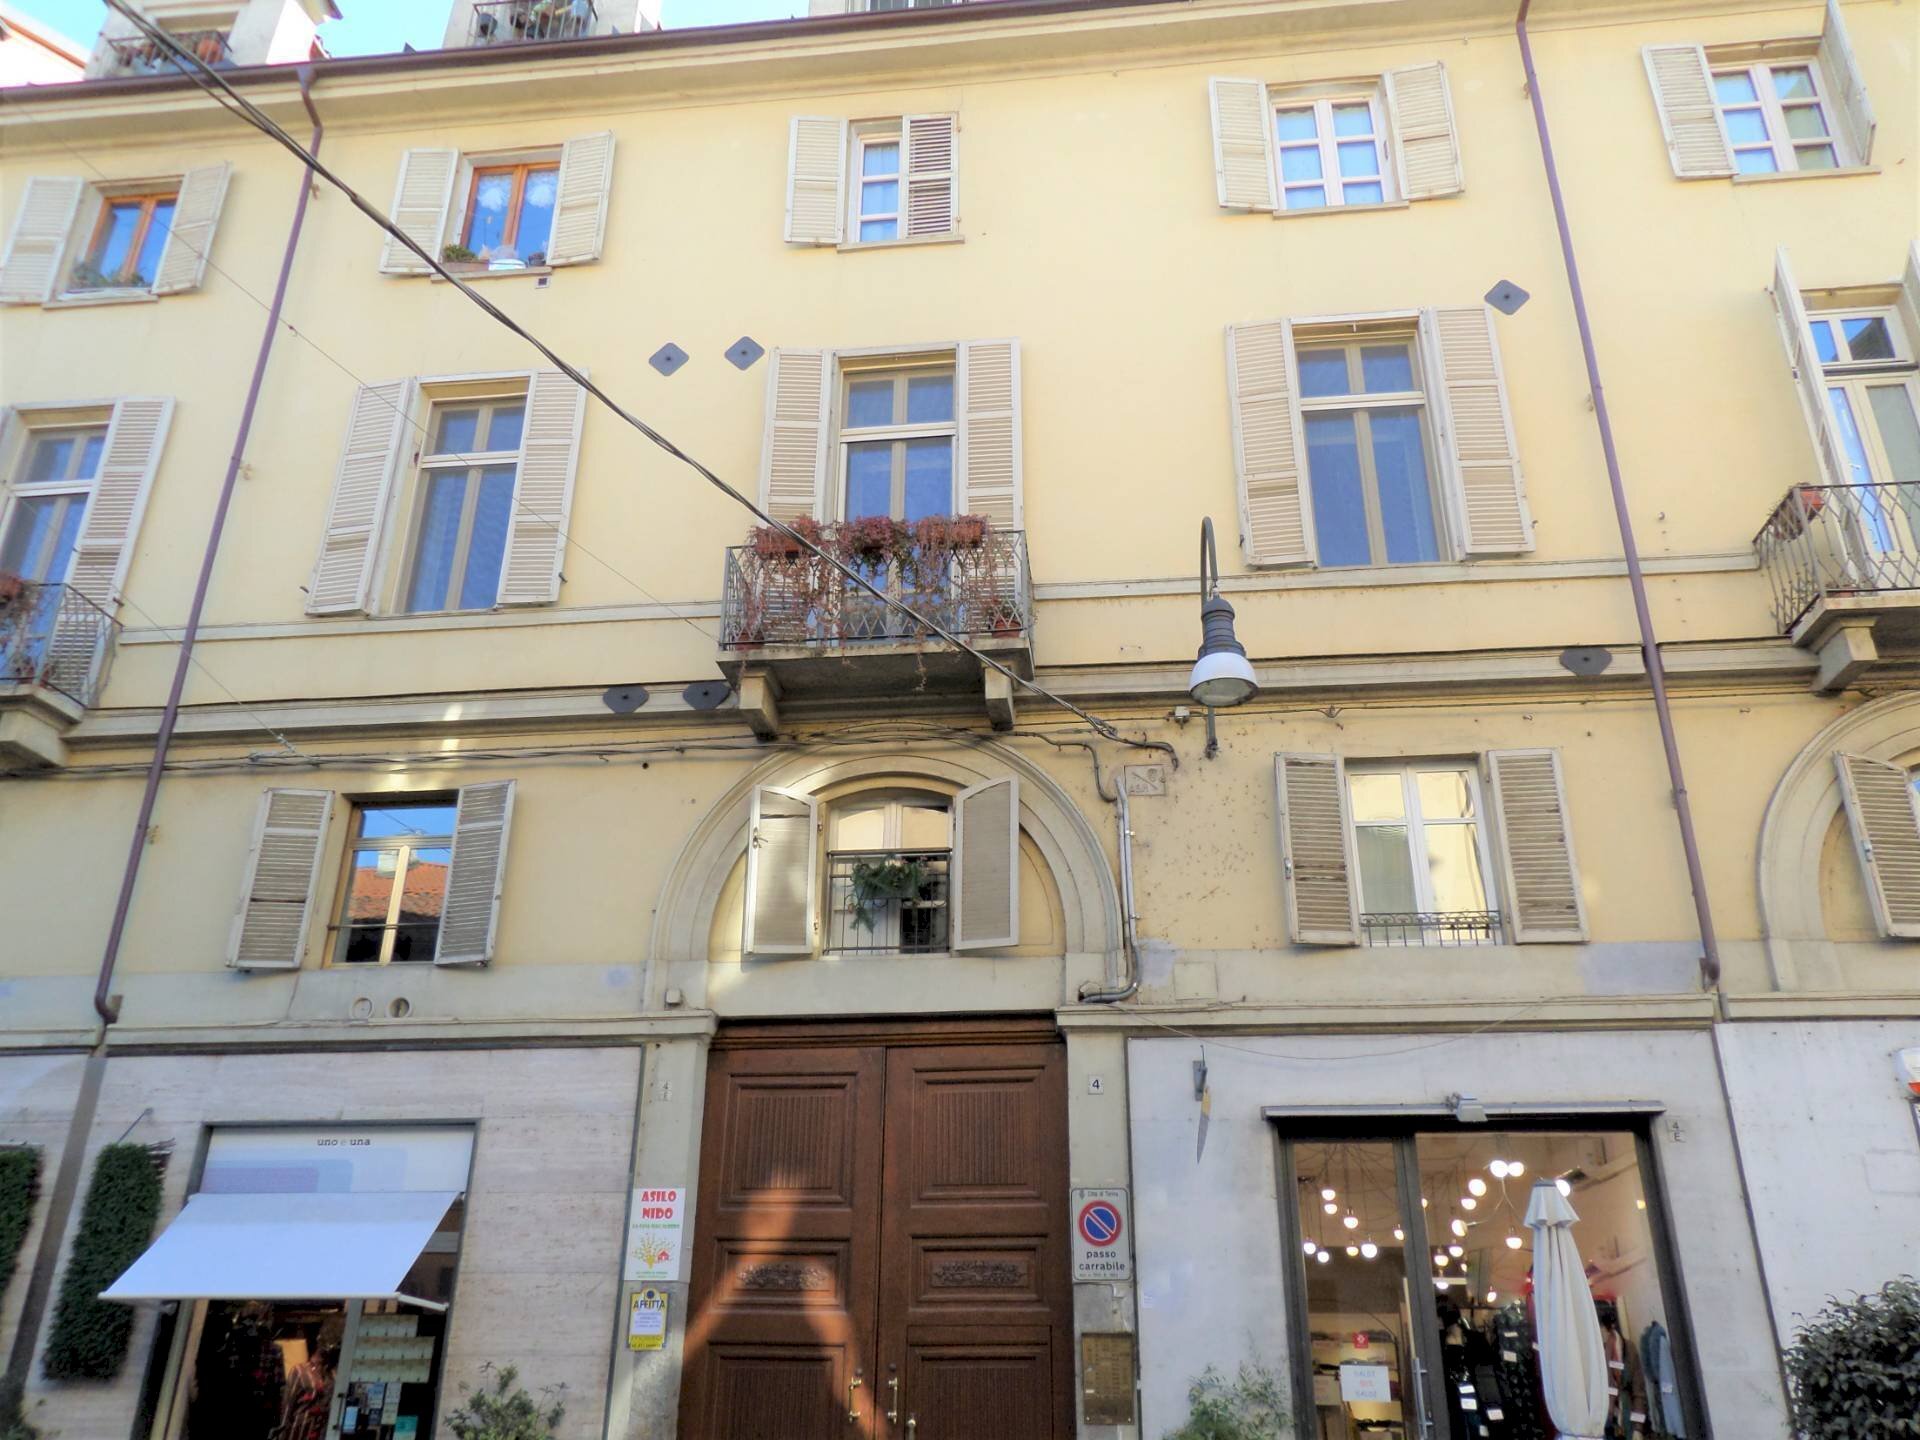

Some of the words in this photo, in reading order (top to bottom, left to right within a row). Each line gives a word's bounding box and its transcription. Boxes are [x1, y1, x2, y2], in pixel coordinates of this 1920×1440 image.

[1092, 1079, 1100, 1091] 4
[317, 1138, 338, 1146] uno
[350, 1138, 371, 1146] una
[641, 1190, 677, 1202] ASILO
[642, 1207, 674, 1219] NIDO
[1086, 1250, 1117, 1260] passo
[1079, 1261, 1126, 1271] carrabile
